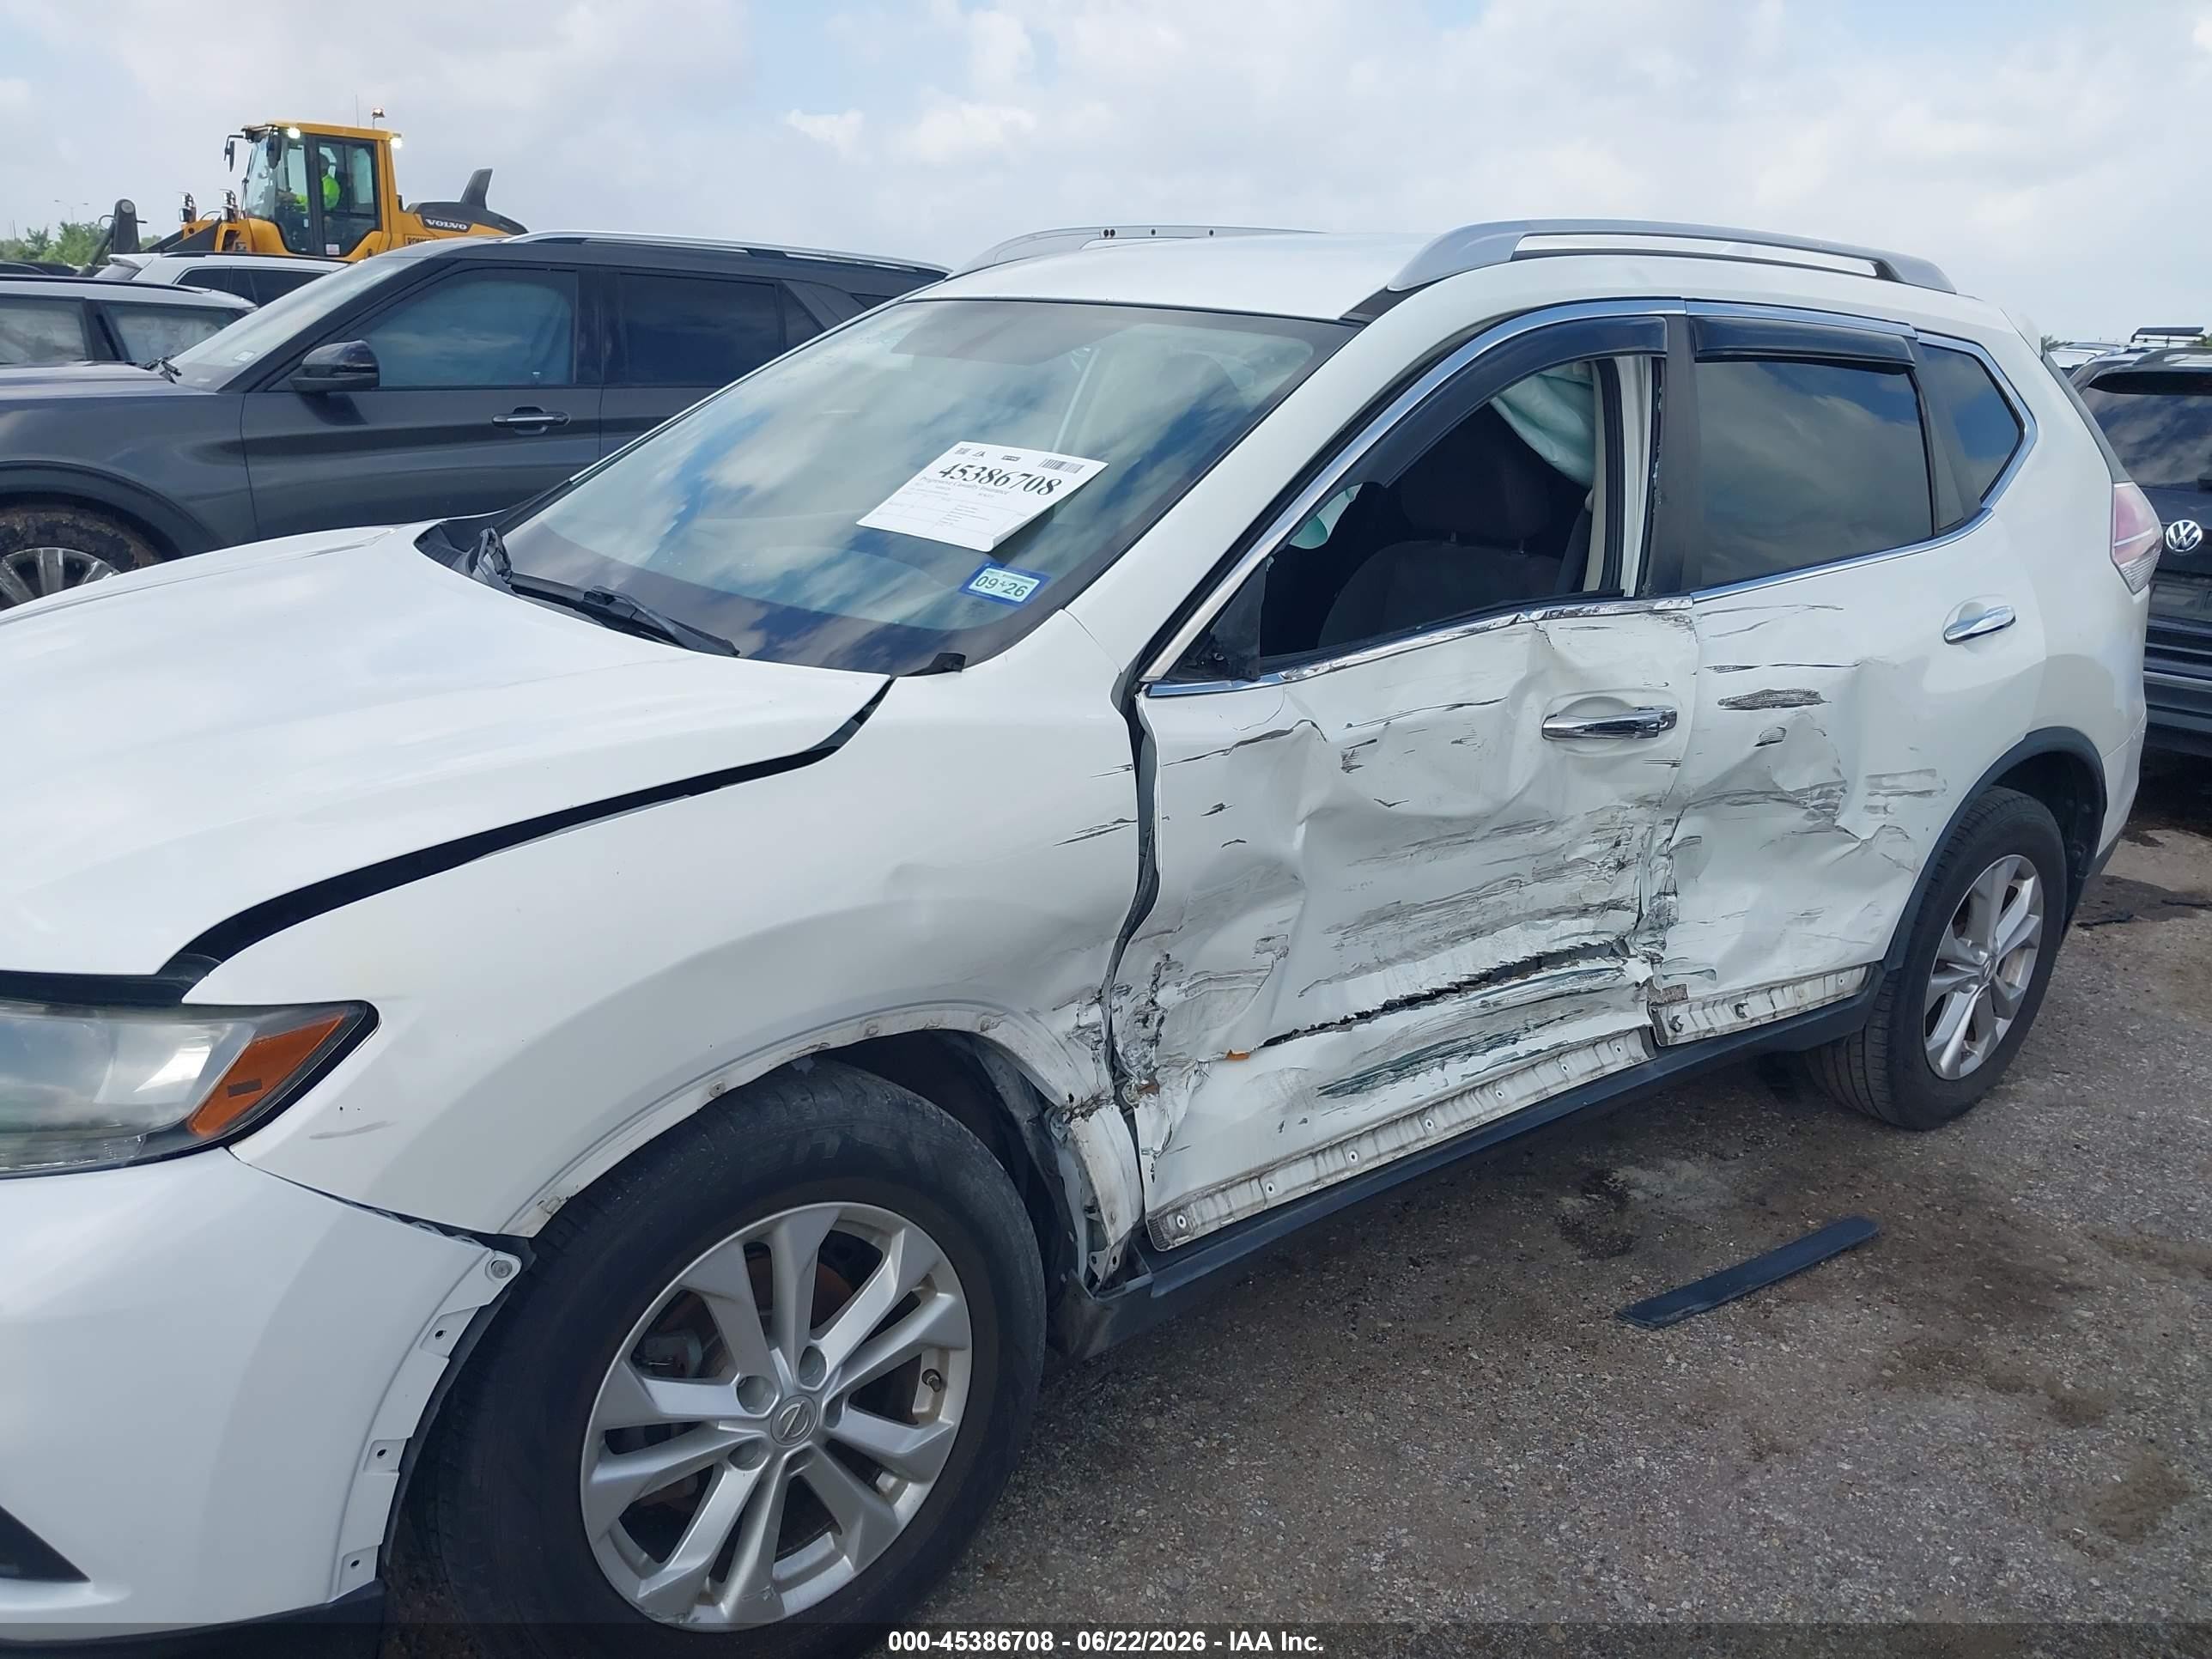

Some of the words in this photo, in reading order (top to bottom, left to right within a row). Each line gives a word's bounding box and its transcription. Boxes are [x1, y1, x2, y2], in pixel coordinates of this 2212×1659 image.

[425, 218, 468, 230] VOLVO
[939, 463, 1062, 495] 45386708
[975, 576, 999, 589] 09
[1002, 582, 1028, 597] 26
